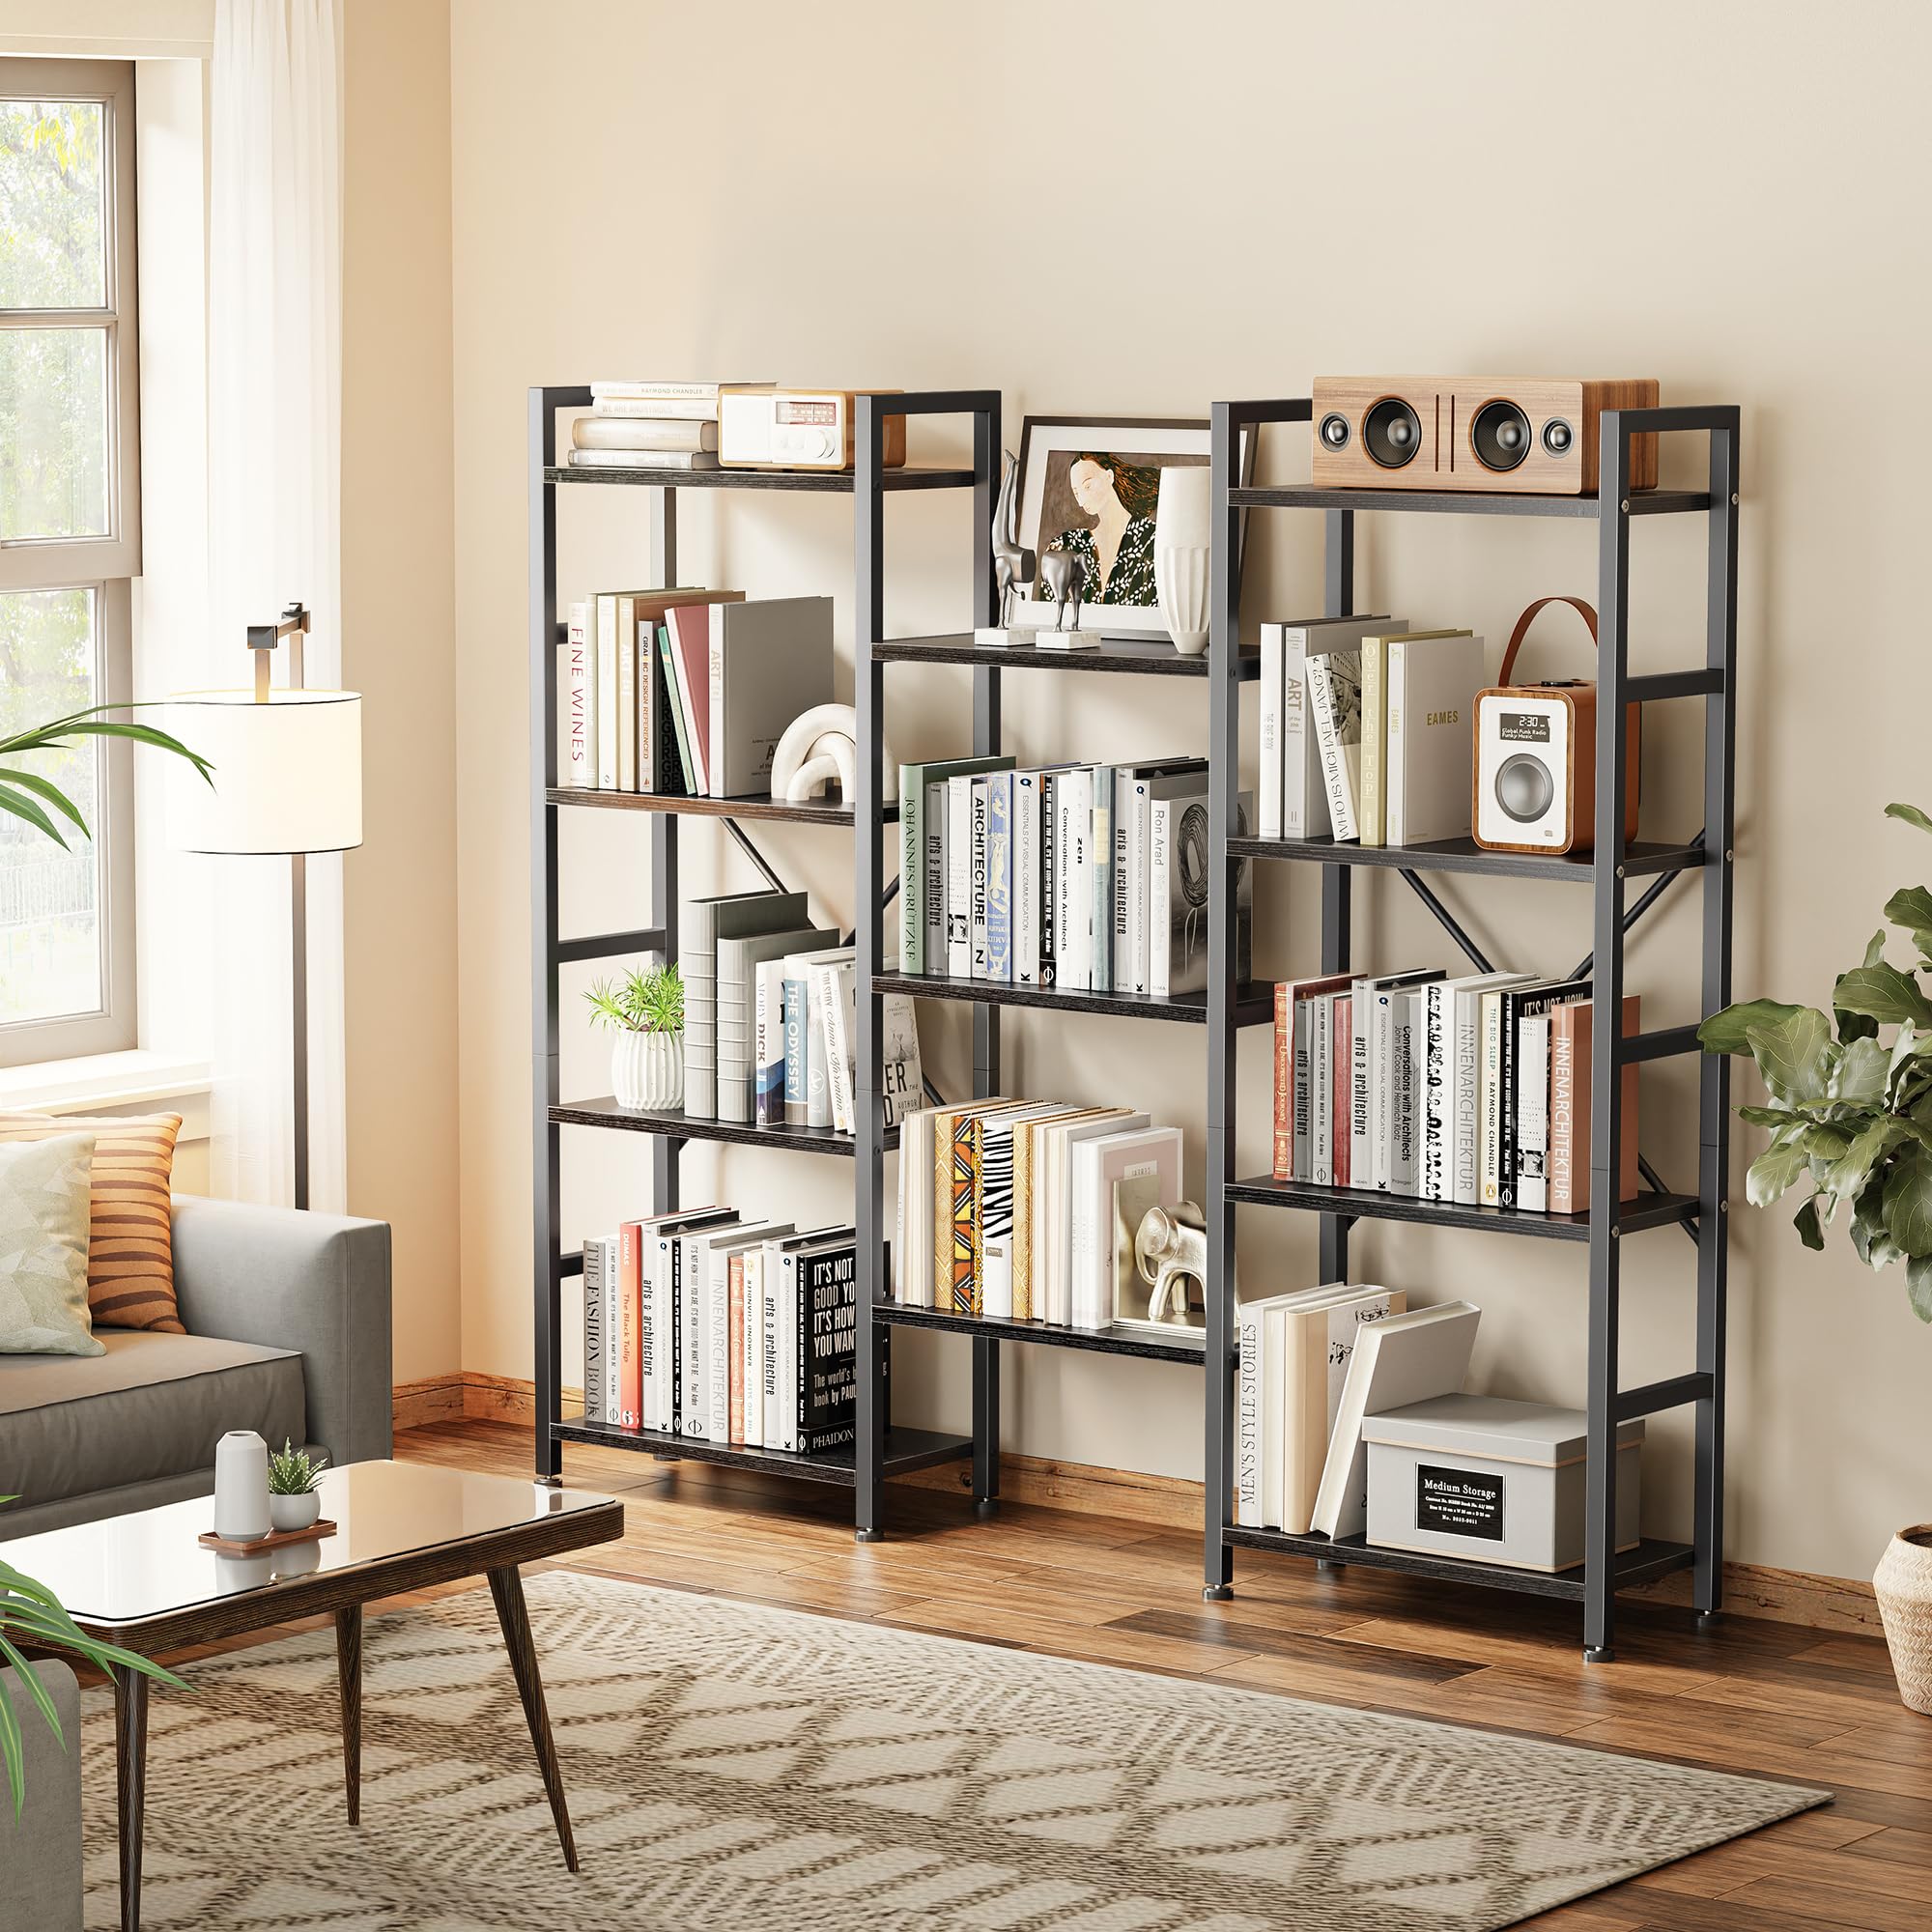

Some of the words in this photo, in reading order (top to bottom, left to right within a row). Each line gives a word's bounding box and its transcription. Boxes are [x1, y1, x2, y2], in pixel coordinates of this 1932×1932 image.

[571, 628, 583, 676] FINE
[622, 644, 633, 673] ART
[710, 648, 721, 680] ART
[1288, 677, 1302, 711] ART
[1312, 668, 1329, 714] JANG?
[571, 688, 583, 761] WINES
[1391, 709, 1400, 734] EAMES
[1427, 710, 1459, 725] EAMES
[1519, 716, 1538, 727] 2:30
[1321, 716, 1340, 781] MICHAEL
[1331, 784, 1343, 798] IS
[1153, 810, 1164, 834] Ron
[1334, 801, 1349, 839] WHO
[904, 796, 917, 882] JOHANNES
[928, 835, 943, 854] arts
[1022, 837, 1030, 847] OF
[1061, 807, 1069, 877] Conversations
[1116, 828, 1127, 850] arts
[1137, 844, 1143, 855] OF
[1153, 837, 1164, 866] Arad
[975, 797, 985, 926] ARCHITECTURE
[928, 868, 943, 926] architecture
[1061, 879, 1069, 899] with
[1116, 867, 1127, 935] architecture
[904, 885, 917, 961] GRÜTZKE
[1061, 902, 1069, 952] Architects
[787, 984, 800, 1017] THE
[1524, 1001, 1541, 1016] IT'S
[757, 1023, 766, 1063] DICK
[825, 1011, 836, 1047] Anna
[1393, 1025, 1402, 1050] John
[787, 1021, 800, 1098] ODYSSEY
[1296, 1049, 1309, 1067] arts
[1354, 1037, 1367, 1057] arts
[1378, 1053, 1386, 1063] OF
[1401, 1025, 1411, 1092] Conversations
[1393, 1075, 1402, 1091] and
[1296, 1082, 1309, 1136] architecture
[1354, 1073, 1367, 1136] architecture
[1393, 1092, 1402, 1122] Heinrich
[1401, 1094, 1411, 1113] with
[1460, 1024, 1474, 1190] INNENARCHITEKTUR
[1554, 1037, 1571, 1199] INNENARCHITEKTUR
[1393, 1123, 1402, 1141] Klotz
[1401, 1115, 1411, 1162] Architects
[586, 1244, 600, 1282] THE
[813, 1262, 832, 1286] IT'S
[835, 1257, 854, 1282] NOT
[622, 1293, 631, 1306] The
[642, 1279, 653, 1299] arts
[813, 1285, 839, 1311] GOOD
[842, 1281, 856, 1304] YO
[764, 1296, 777, 1318] arts
[813, 1309, 832, 1334] IT'S
[835, 1305, 856, 1330] HOW
[586, 1285, 600, 1362] FASHION
[622, 1308, 631, 1337] Black
[622, 1340, 631, 1363] Tulip
[642, 1315, 653, 1377] architecture
[713, 1278, 724, 1431] INNENARCHITEKTUR
[813, 1333, 832, 1359] YOU
[1241, 1323, 1256, 1394] STORIES
[764, 1333, 777, 1396] architecture
[813, 1374, 826, 1389] The
[828, 1367, 850, 1385] world's
[586, 1367, 600, 1418] BOOK
[813, 1391, 830, 1407] book
[831, 1389, 839, 1406] by
[840, 1384, 857, 1402] PAUL
[812, 1428, 855, 1449] PHAIDON
[1241, 1397, 1256, 1450] STYLE
[1240, 1454, 1256, 1505] MEN'S
[1424, 1478, 1461, 1493] Medium
[1462, 1484, 1496, 1500] Storage
